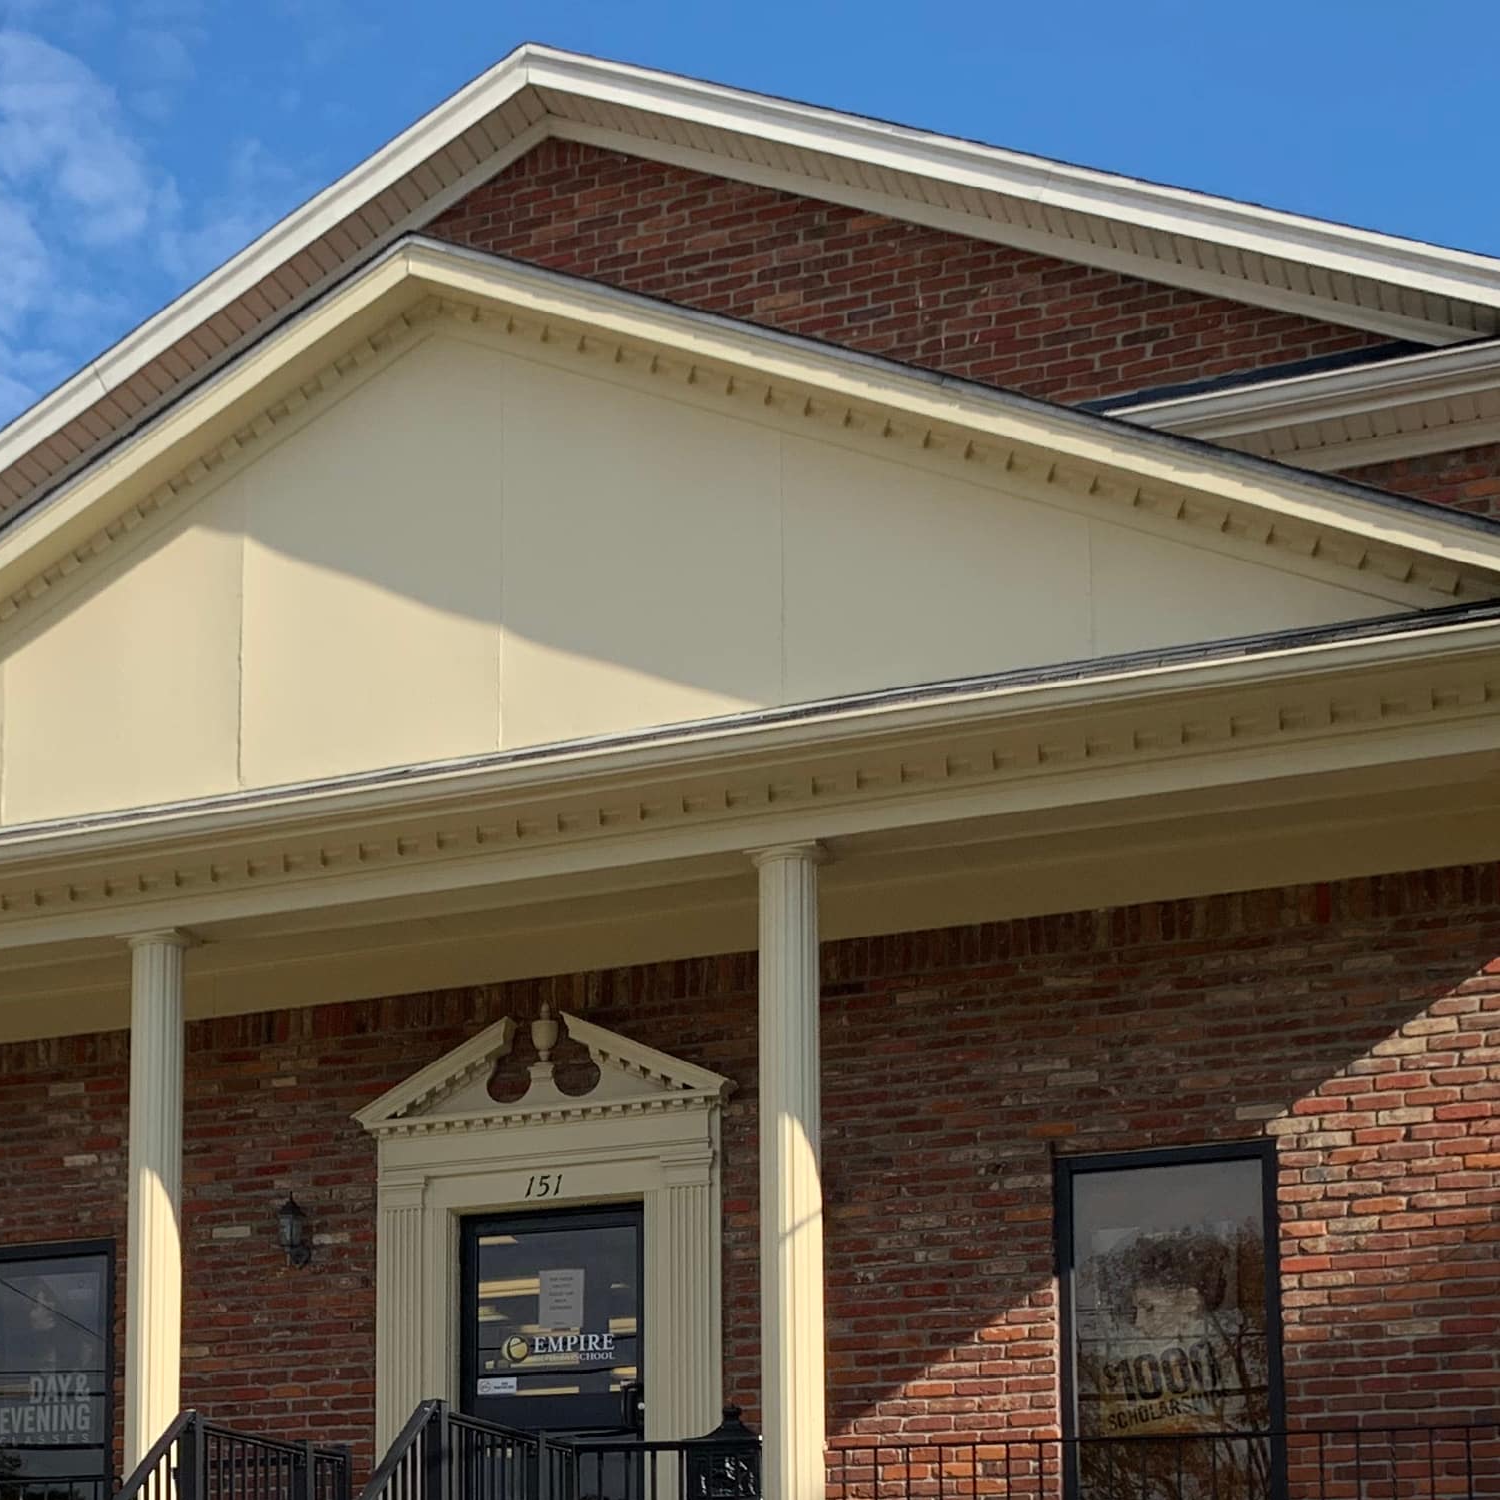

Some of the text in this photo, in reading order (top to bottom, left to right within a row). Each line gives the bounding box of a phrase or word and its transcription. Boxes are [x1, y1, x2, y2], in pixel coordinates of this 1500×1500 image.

[525, 1174, 563, 1198] 151
[532, 1333, 616, 1353] EMPIRE
[29, 1373, 92, 1404] DAY &
[0, 1403, 91, 1435] EVENING
